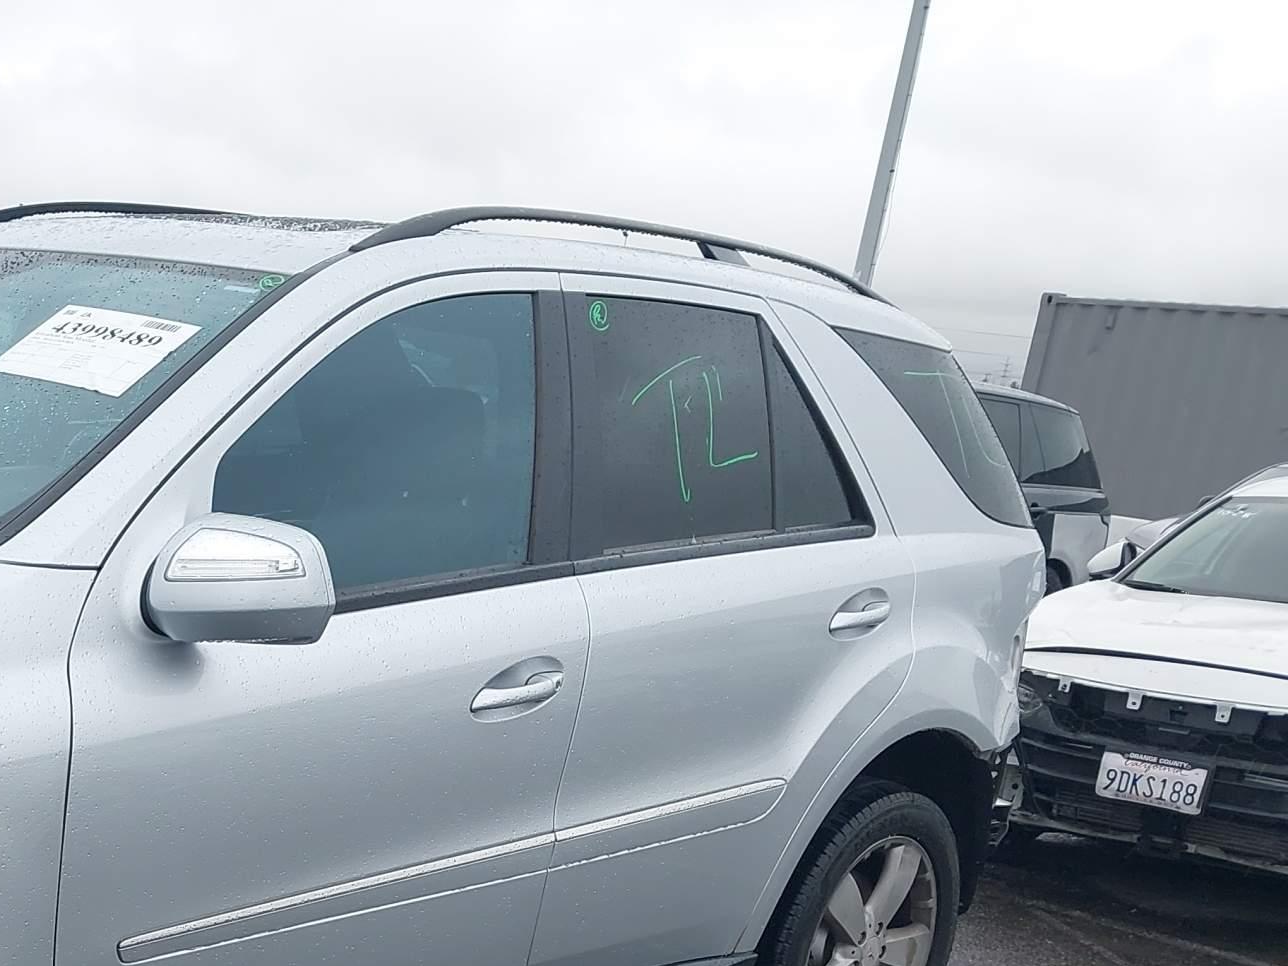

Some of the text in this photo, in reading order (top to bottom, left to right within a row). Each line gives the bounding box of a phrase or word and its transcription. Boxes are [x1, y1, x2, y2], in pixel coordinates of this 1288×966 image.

[52, 320, 163, 348] 43998489
[1129, 752, 1189, 769] ORANGE COUNTY
[1103, 768, 1198, 806] 9DKS188
